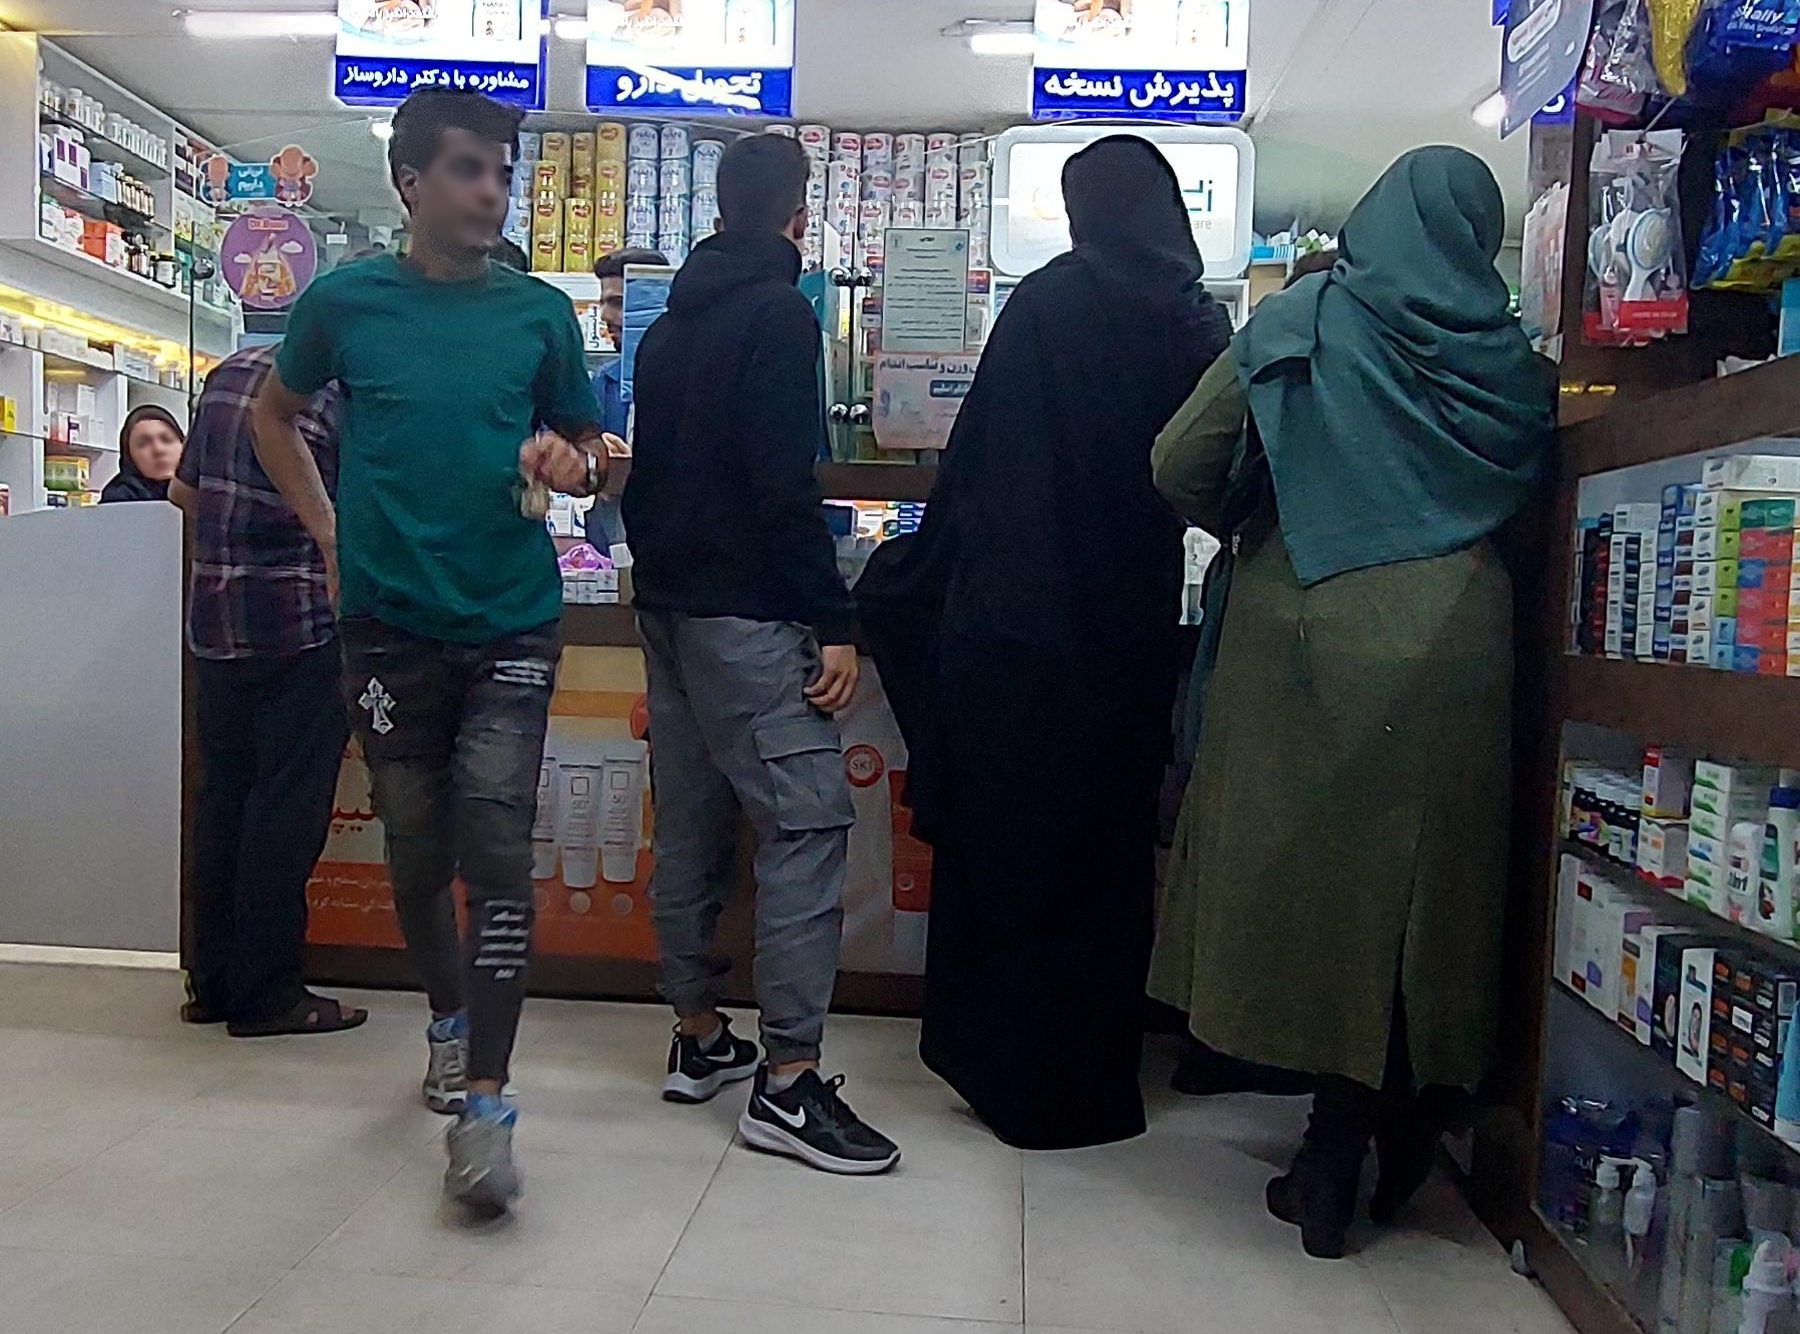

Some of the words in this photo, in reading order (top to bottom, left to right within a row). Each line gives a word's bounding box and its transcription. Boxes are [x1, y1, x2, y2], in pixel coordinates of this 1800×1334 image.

[344, 66, 407, 87] داروساز
[410, 69, 451, 88] دکتر
[453, 69, 466, 89] با
[468, 70, 530, 91] مشاوره
[1044, 71, 1124, 98] نسخه
[1130, 71, 1235, 107] پذیرش
